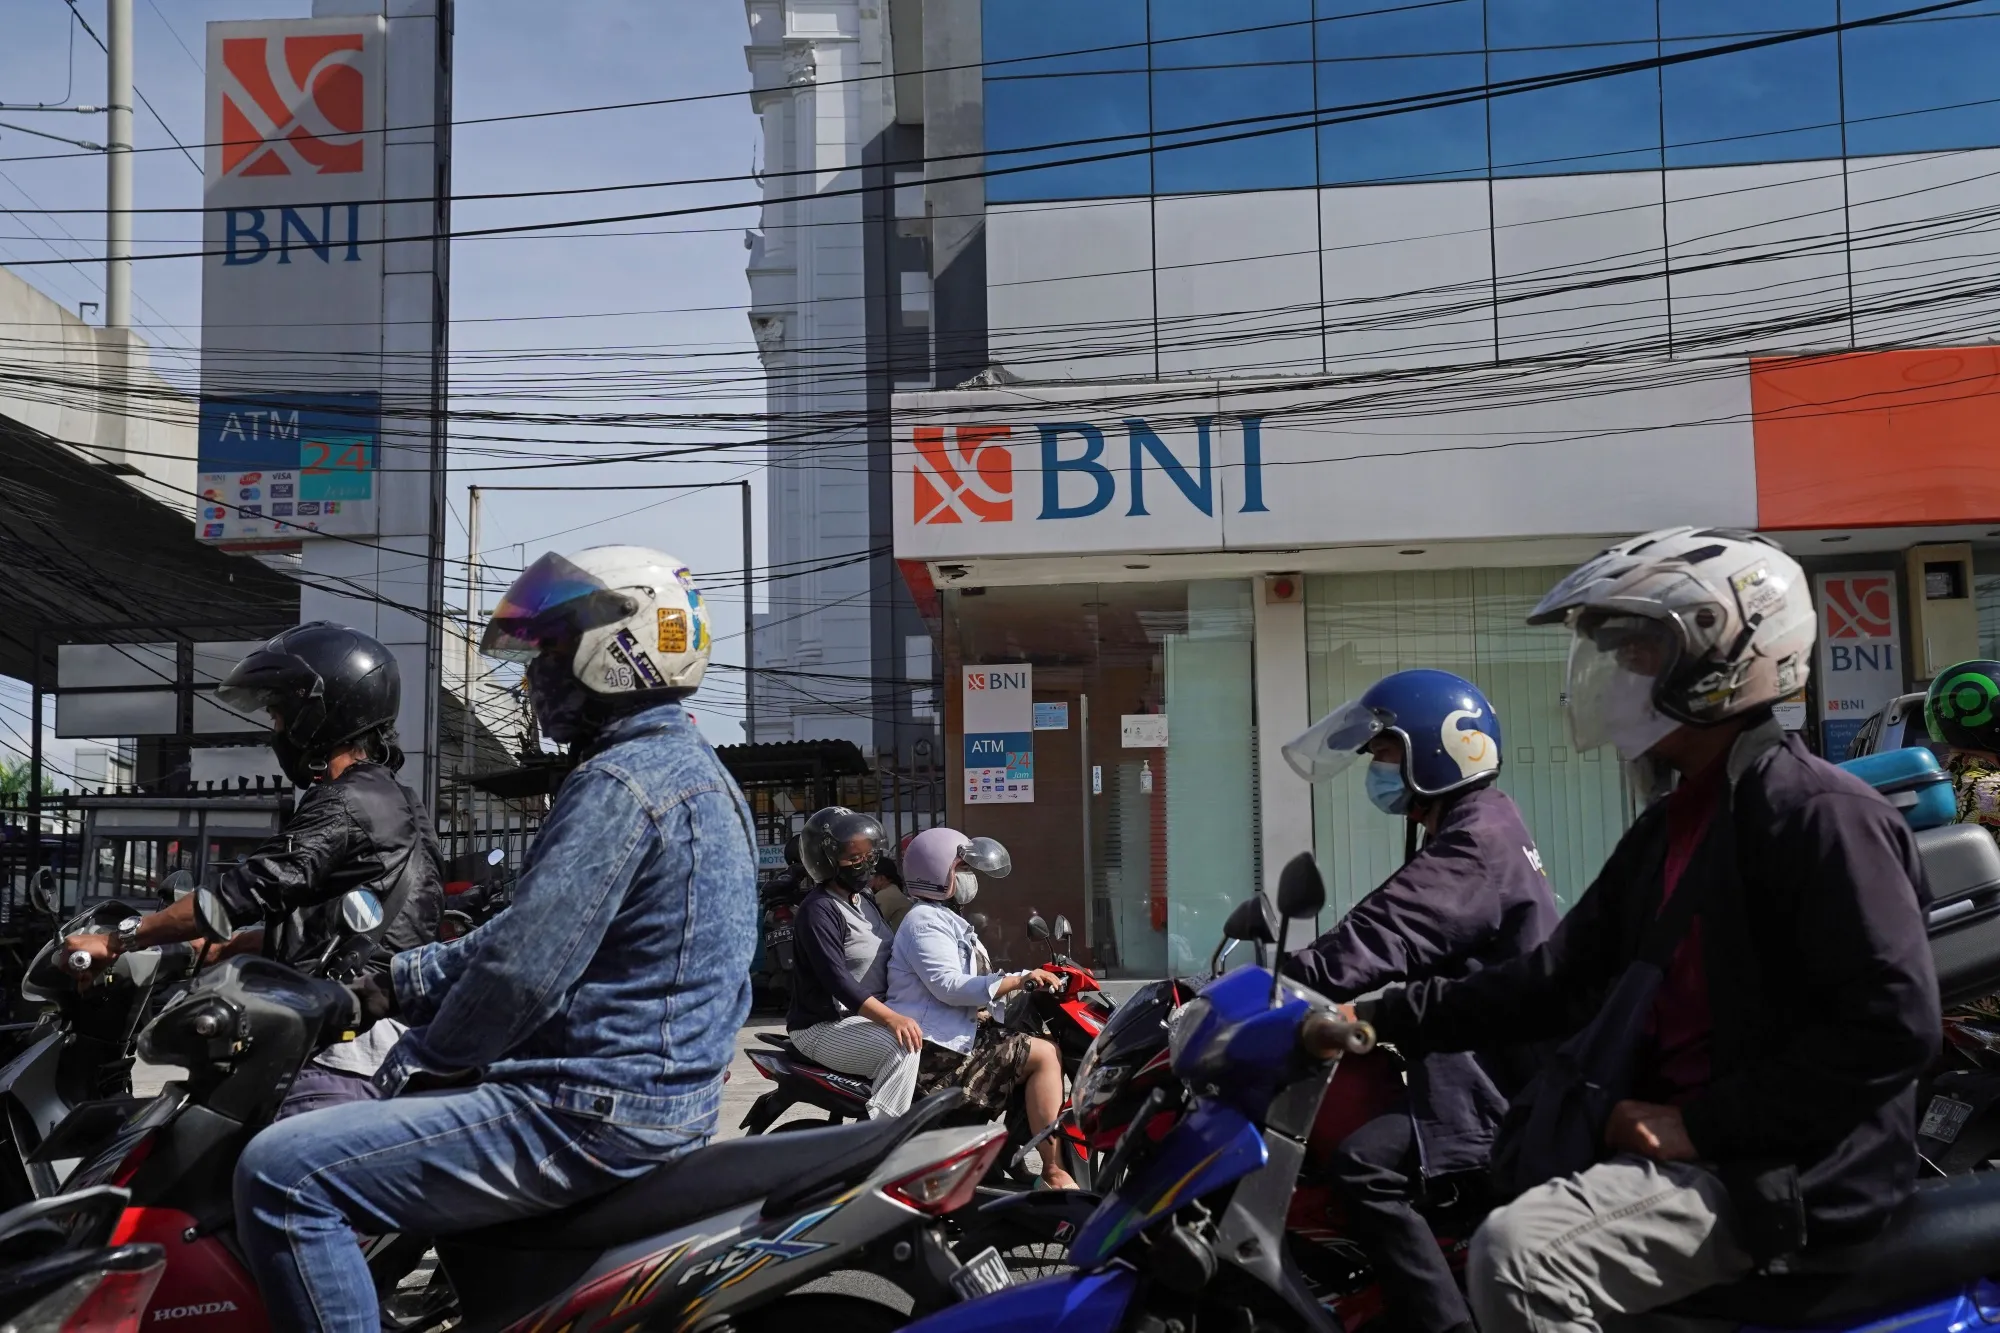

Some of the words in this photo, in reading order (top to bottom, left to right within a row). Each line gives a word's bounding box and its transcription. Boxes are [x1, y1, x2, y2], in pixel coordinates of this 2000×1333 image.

[222, 203, 362, 266] BNI
[219, 410, 299, 442] ATM
[301, 441, 371, 475] 24
[272, 472, 292, 480] VISA
[1034, 416, 1270, 520] BNI
[1830, 644, 1894, 672] BNI
[989, 672, 1026, 690] BNI
[1841, 699, 1865, 710] BNI
[971, 739, 1004, 753] ATM
[1006, 751, 1031, 770] 24
[1013, 771, 1030, 779] Jam
[760, 847, 784, 855] PARK
[153, 1300, 238, 1321] HONDA
